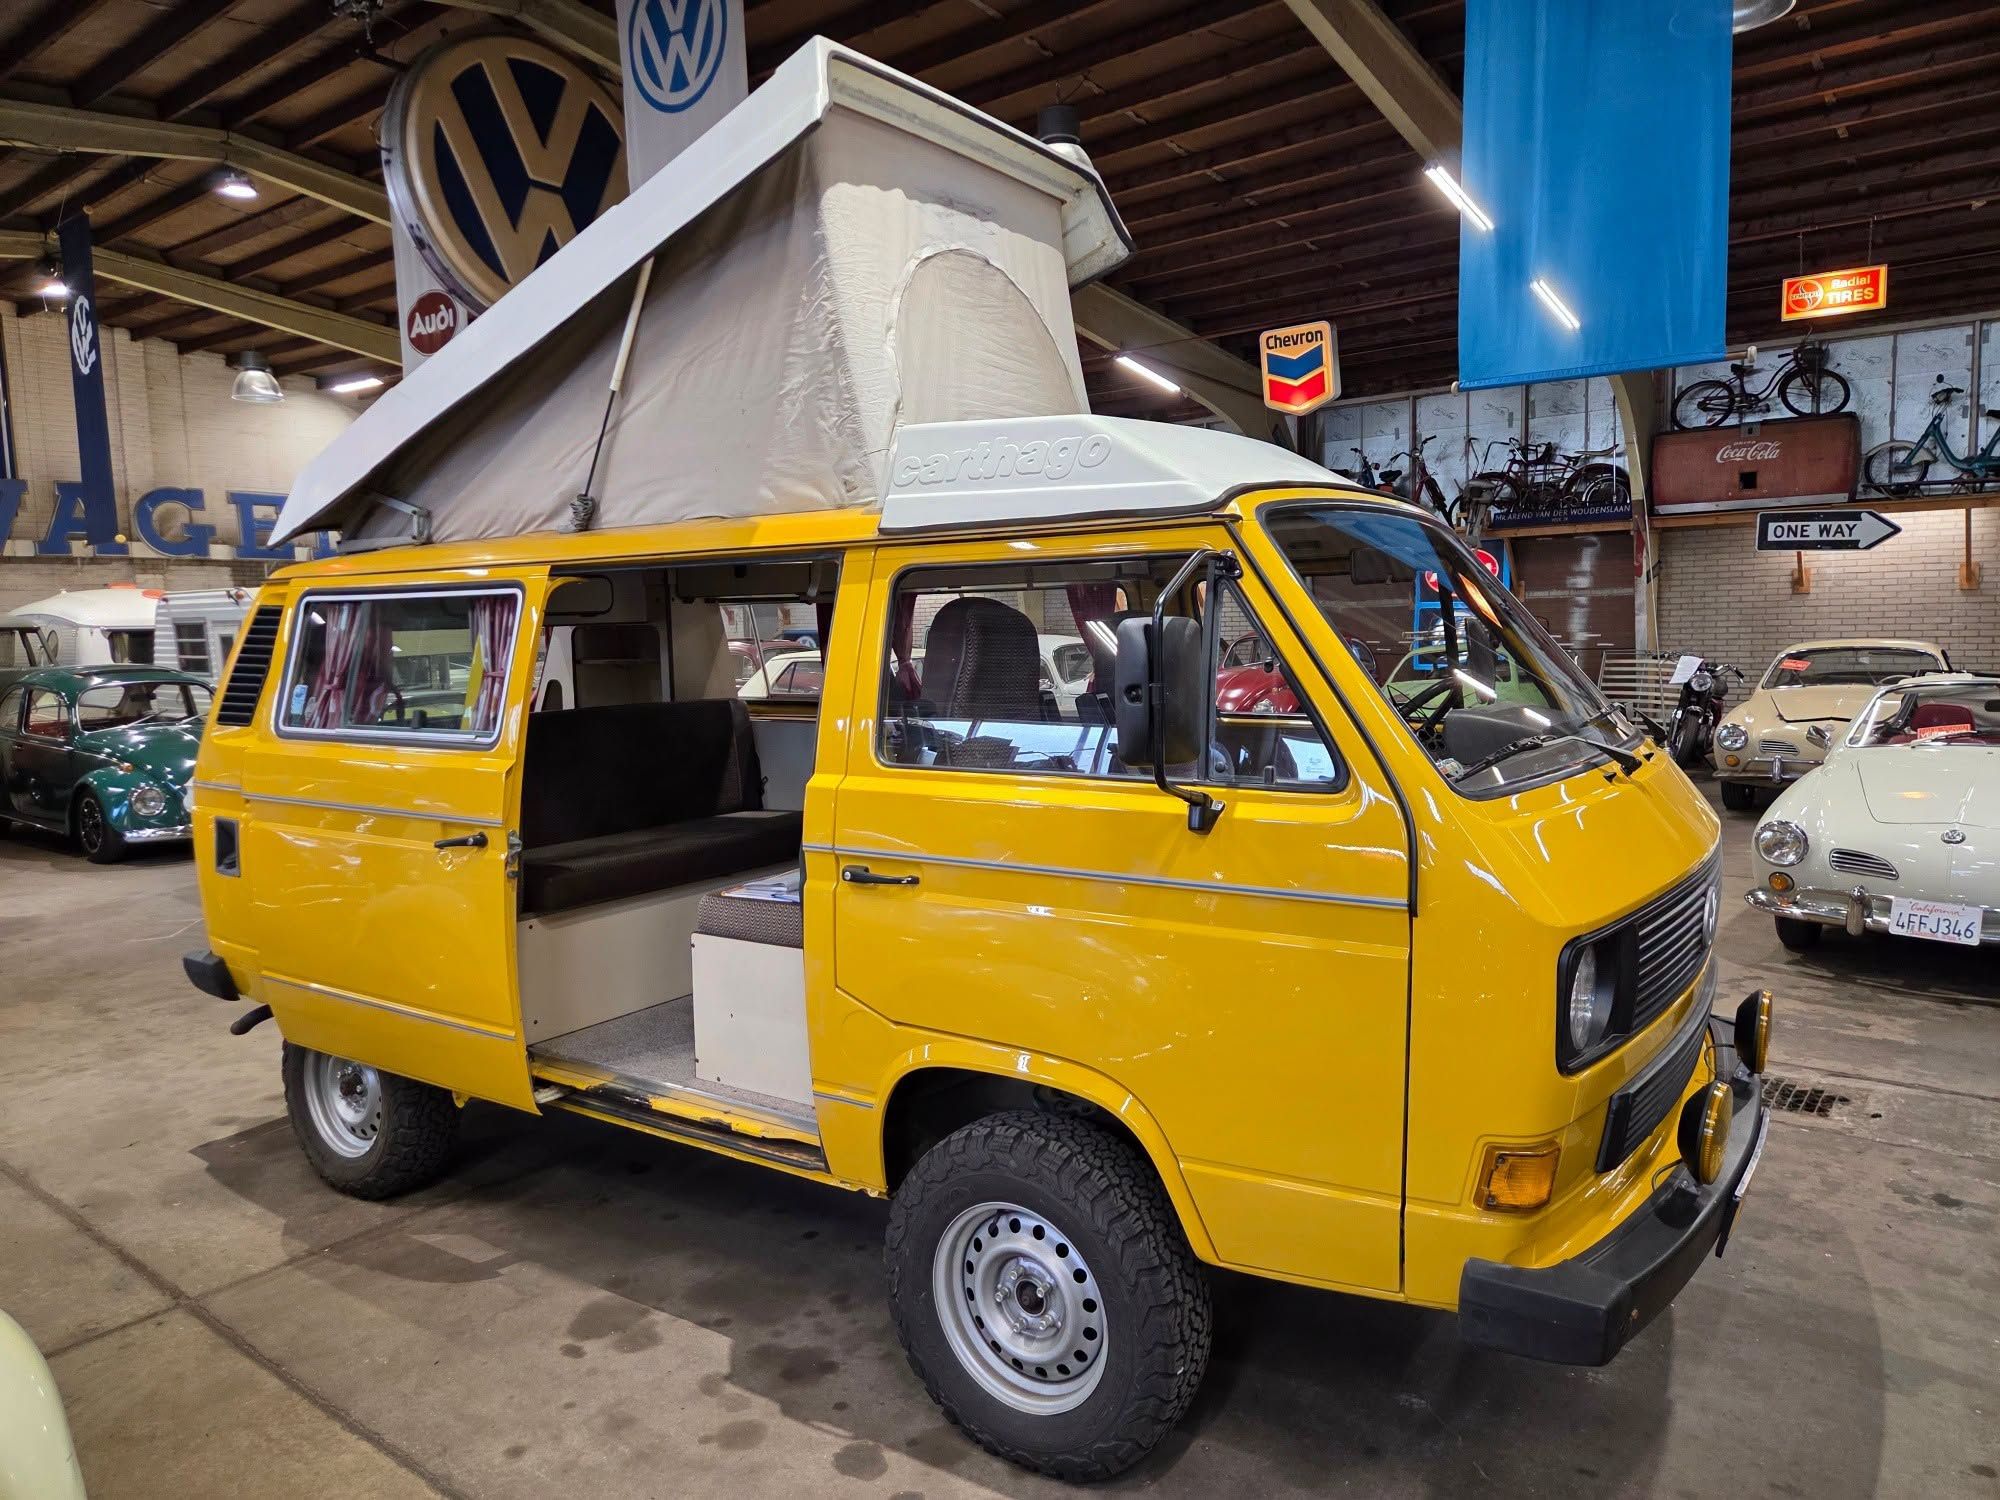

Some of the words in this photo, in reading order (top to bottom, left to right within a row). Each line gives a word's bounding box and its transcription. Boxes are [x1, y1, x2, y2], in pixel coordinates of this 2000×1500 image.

[1831, 275, 1870, 289] Radial
[1825, 287, 1874, 305] TIRES
[410, 304, 454, 338] Audi
[1266, 330, 1323, 350] Chevron
[893, 433, 1112, 487] carthago
[1716, 441, 1782, 463] Coca-Cola
[1553, 509, 1568, 517] DER
[1570, 505, 1631, 515] WOUDENSLAAN
[1773, 524, 1810, 538] ONE
[1818, 523, 1858, 538] WAY
[1910, 902, 1962, 916] California
[1896, 912, 1976, 939] 4FFJ346
